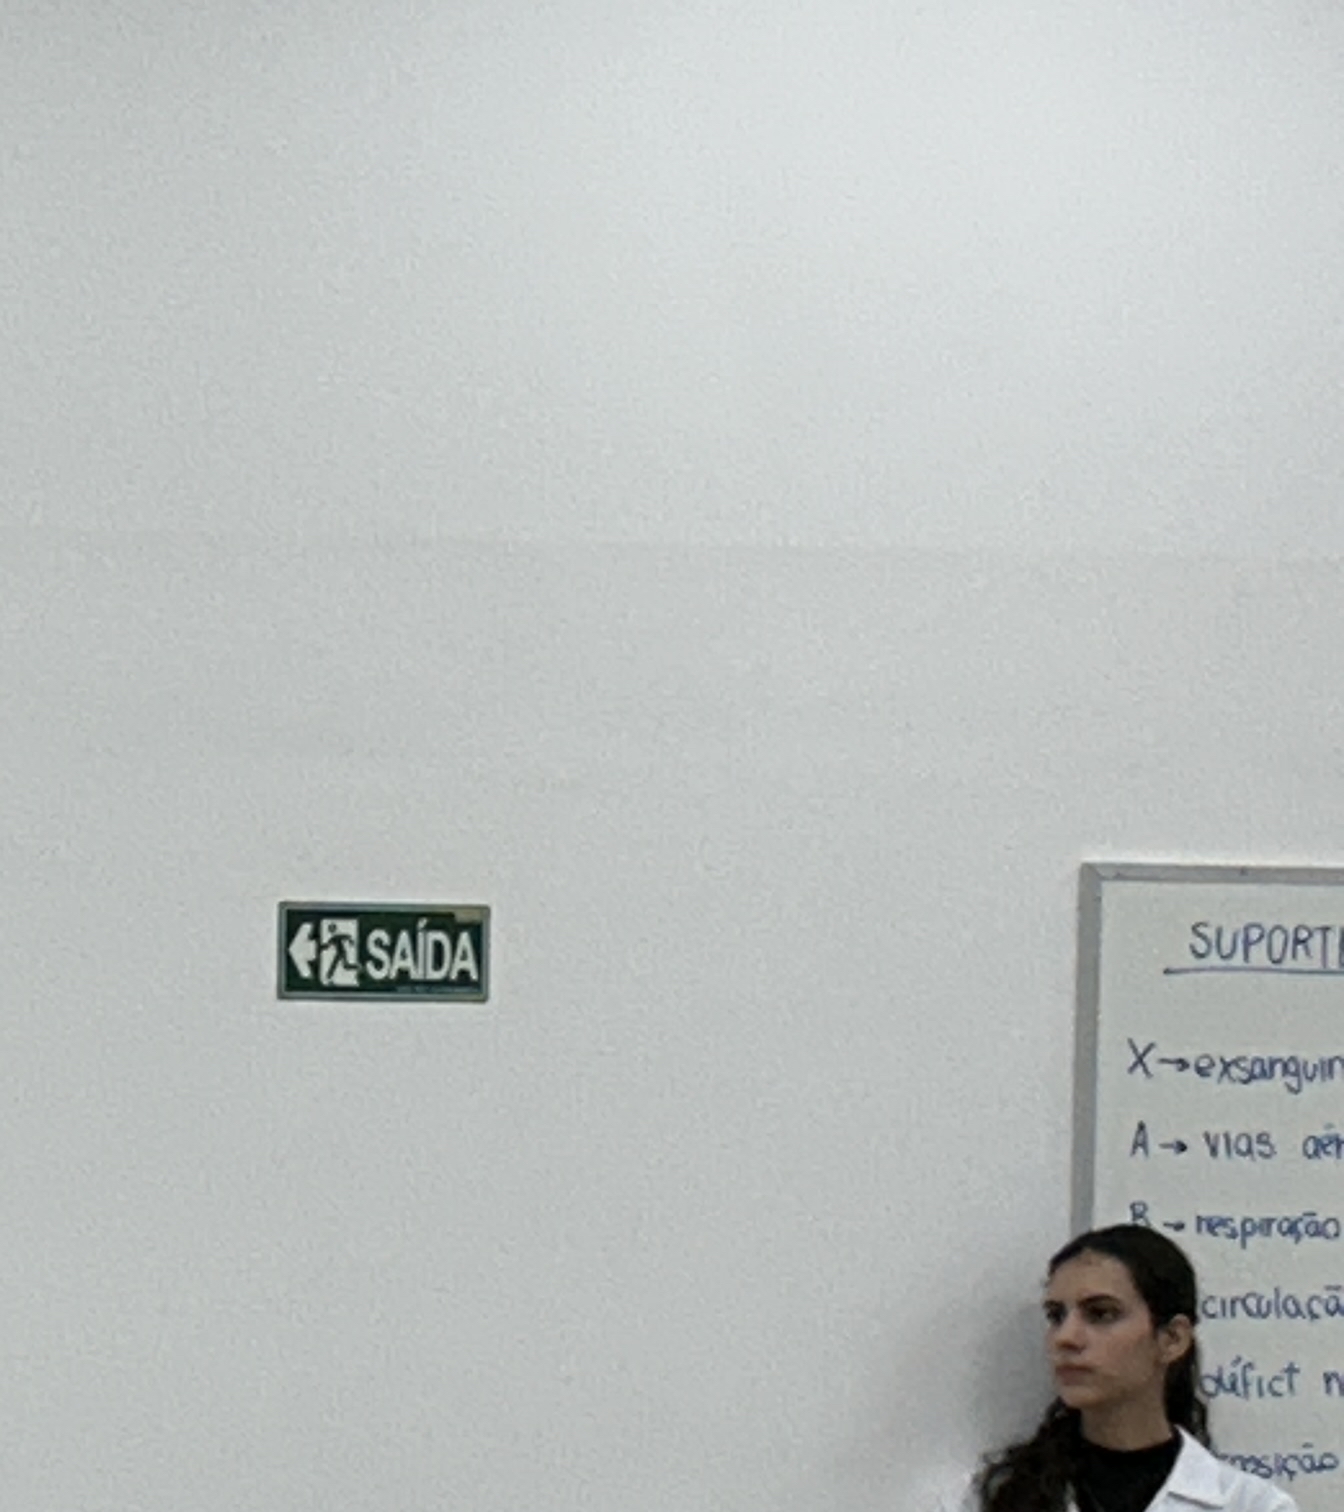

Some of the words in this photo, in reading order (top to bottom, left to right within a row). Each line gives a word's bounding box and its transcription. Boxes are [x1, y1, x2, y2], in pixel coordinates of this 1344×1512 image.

[366, 917, 479, 981] SAÍDA
[1126, 1037, 1157, 1080] X
[1129, 1120, 1150, 1160] A
[1195, 1211, 1340, 1249] respiração
